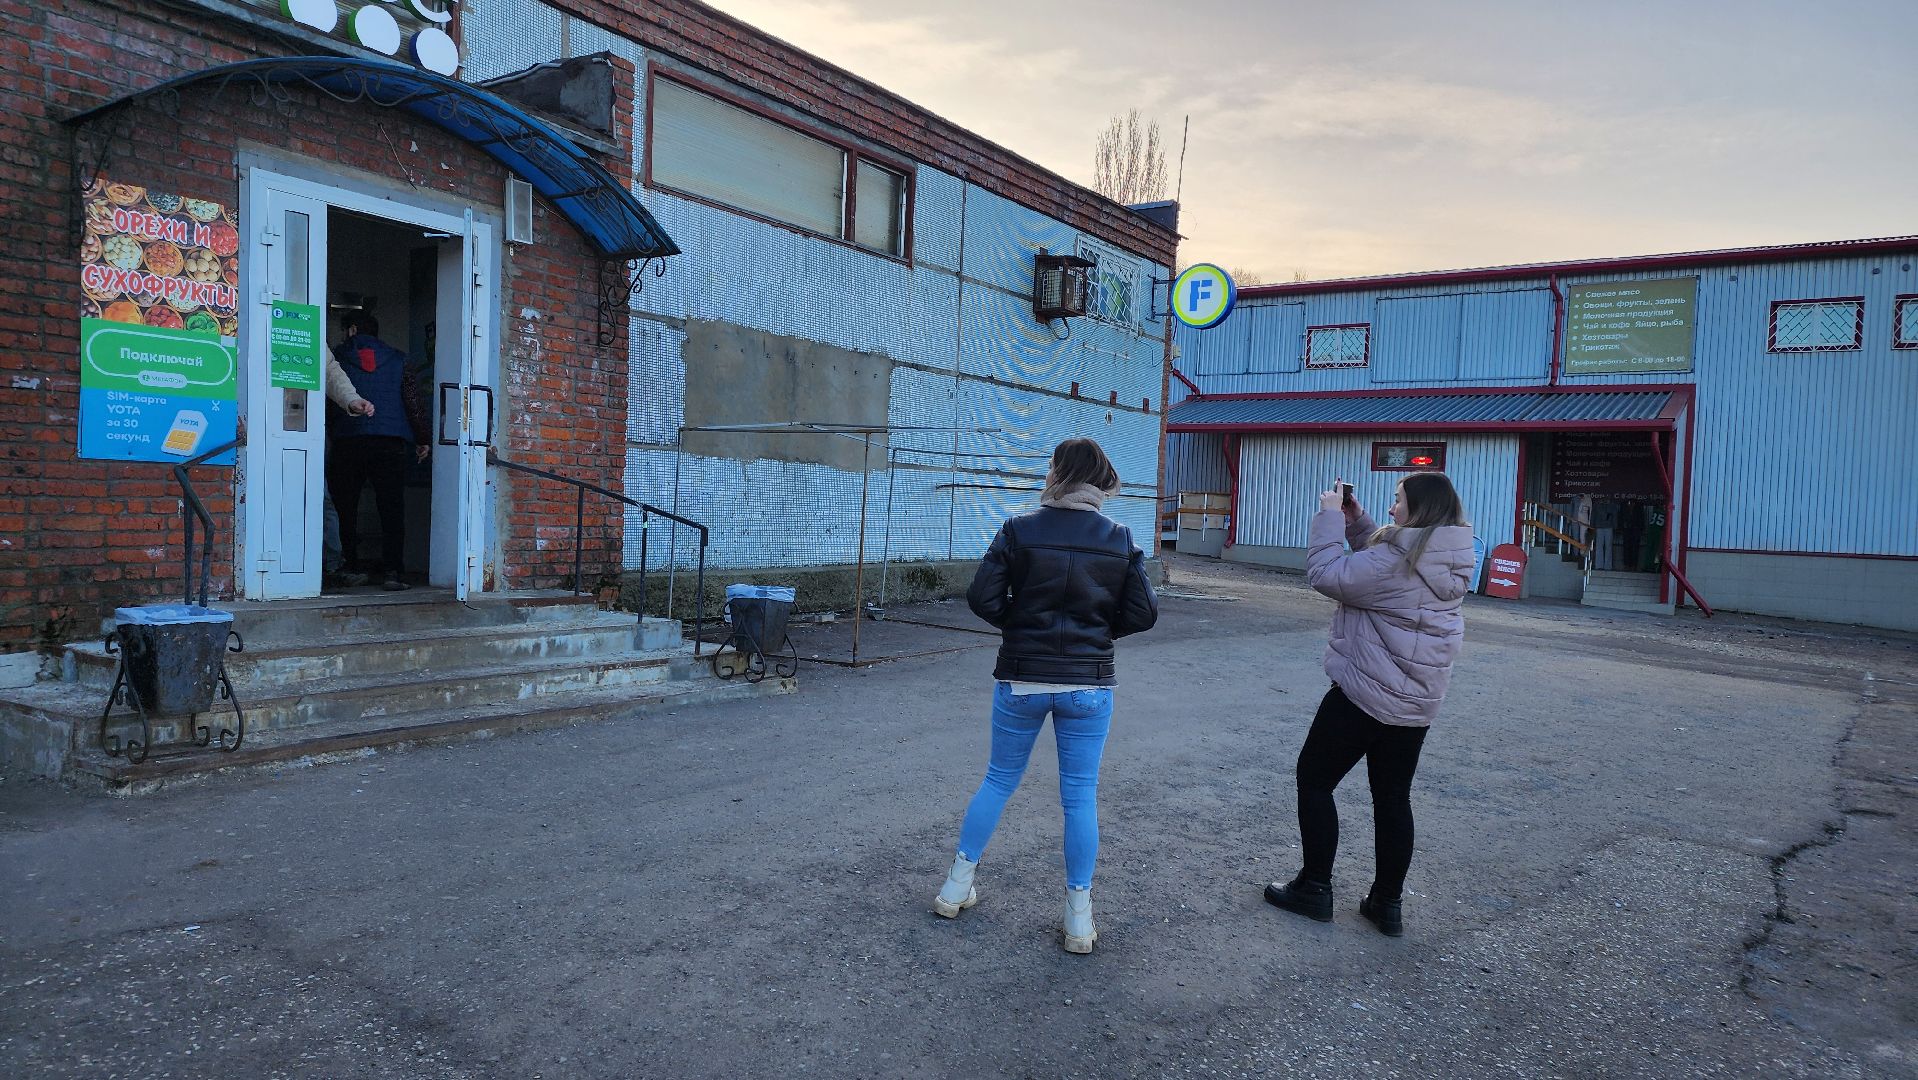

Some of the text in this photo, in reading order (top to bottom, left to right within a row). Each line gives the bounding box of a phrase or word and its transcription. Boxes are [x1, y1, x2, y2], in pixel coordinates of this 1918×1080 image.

[113, 208, 211, 248] ОРЕХИ И
[82, 264, 237, 309] СУХОФРУКТЫ
[1189, 279, 1213, 311] F
[1616, 300, 1653, 308] фрукты,
[1627, 309, 1674, 318] продукция
[1660, 318, 1684, 327] рыба
[1582, 333, 1629, 341] Хозтовары
[1580, 344, 1620, 352] Трикотаж
[120, 347, 203, 367] Подключай
[106, 391, 167, 405] SIM-карта
[106, 404, 141, 415] YOTA
[106, 418, 139, 428] за 30
[179, 418, 199, 427] YOTA
[106, 433, 151, 444] секунд
